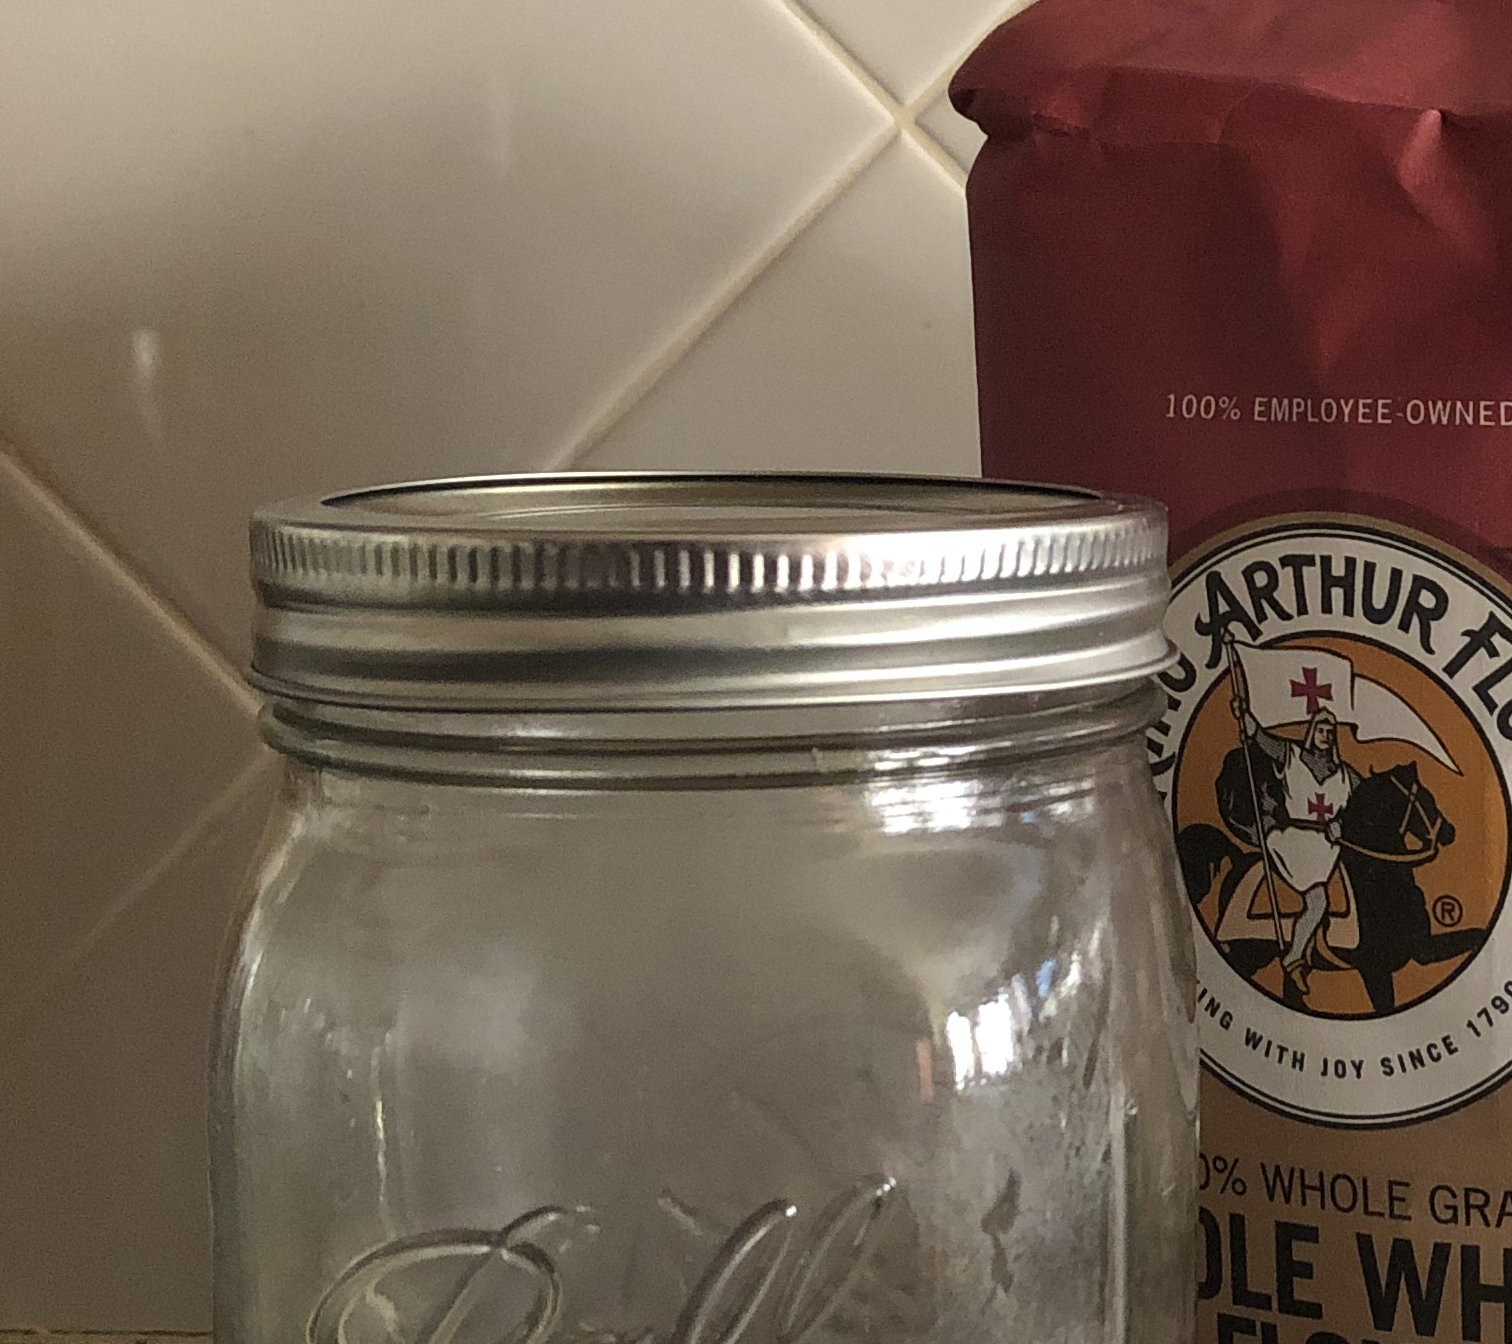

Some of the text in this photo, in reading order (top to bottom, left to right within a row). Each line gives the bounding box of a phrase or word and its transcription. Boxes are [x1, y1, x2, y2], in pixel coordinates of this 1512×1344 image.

[1164, 392, 1242, 423] 100%
[1194, 552, 1451, 670] ARTHUR
[1197, 986, 1234, 1032] ING
[1244, 1026, 1306, 1073] WITH
[1320, 1058, 1365, 1080] JOY
[1380, 1034, 1459, 1077] SINCE
[1261, 1162, 1413, 1223] WHOLE
[1198, 1206, 1325, 1320] OLE
